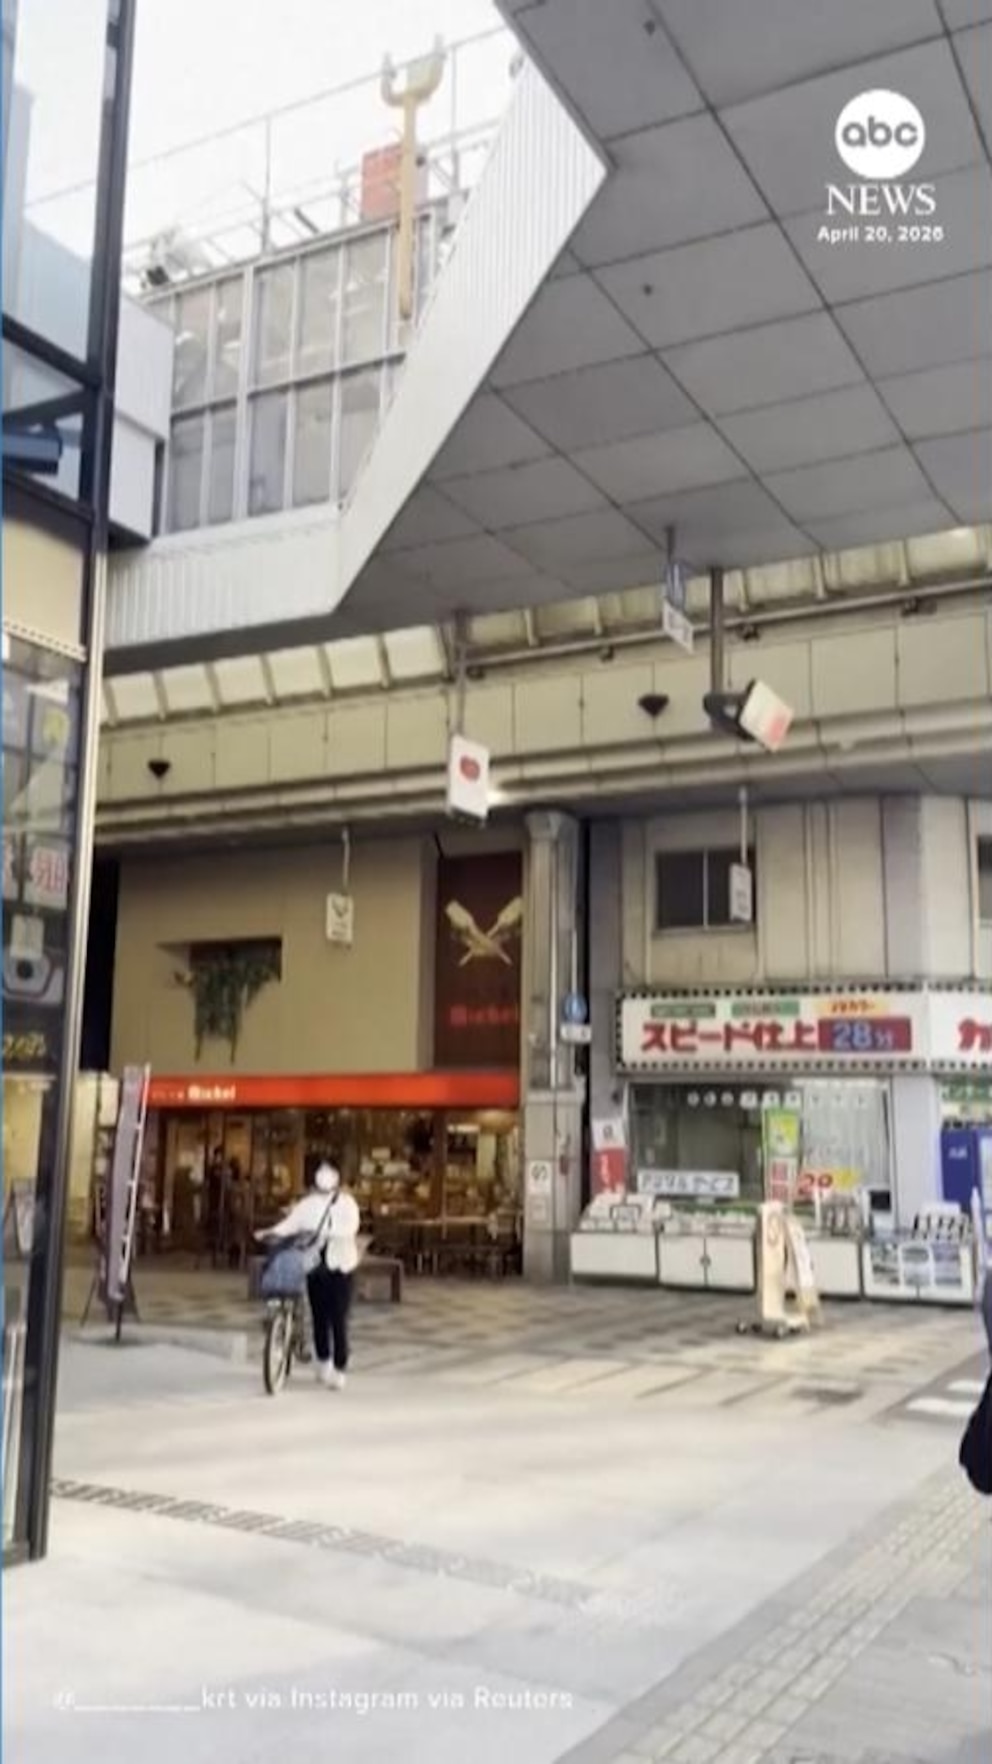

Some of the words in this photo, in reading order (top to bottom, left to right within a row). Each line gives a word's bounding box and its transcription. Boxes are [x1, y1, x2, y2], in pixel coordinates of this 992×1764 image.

[641, 1019, 817, 1053] スピード仕上
